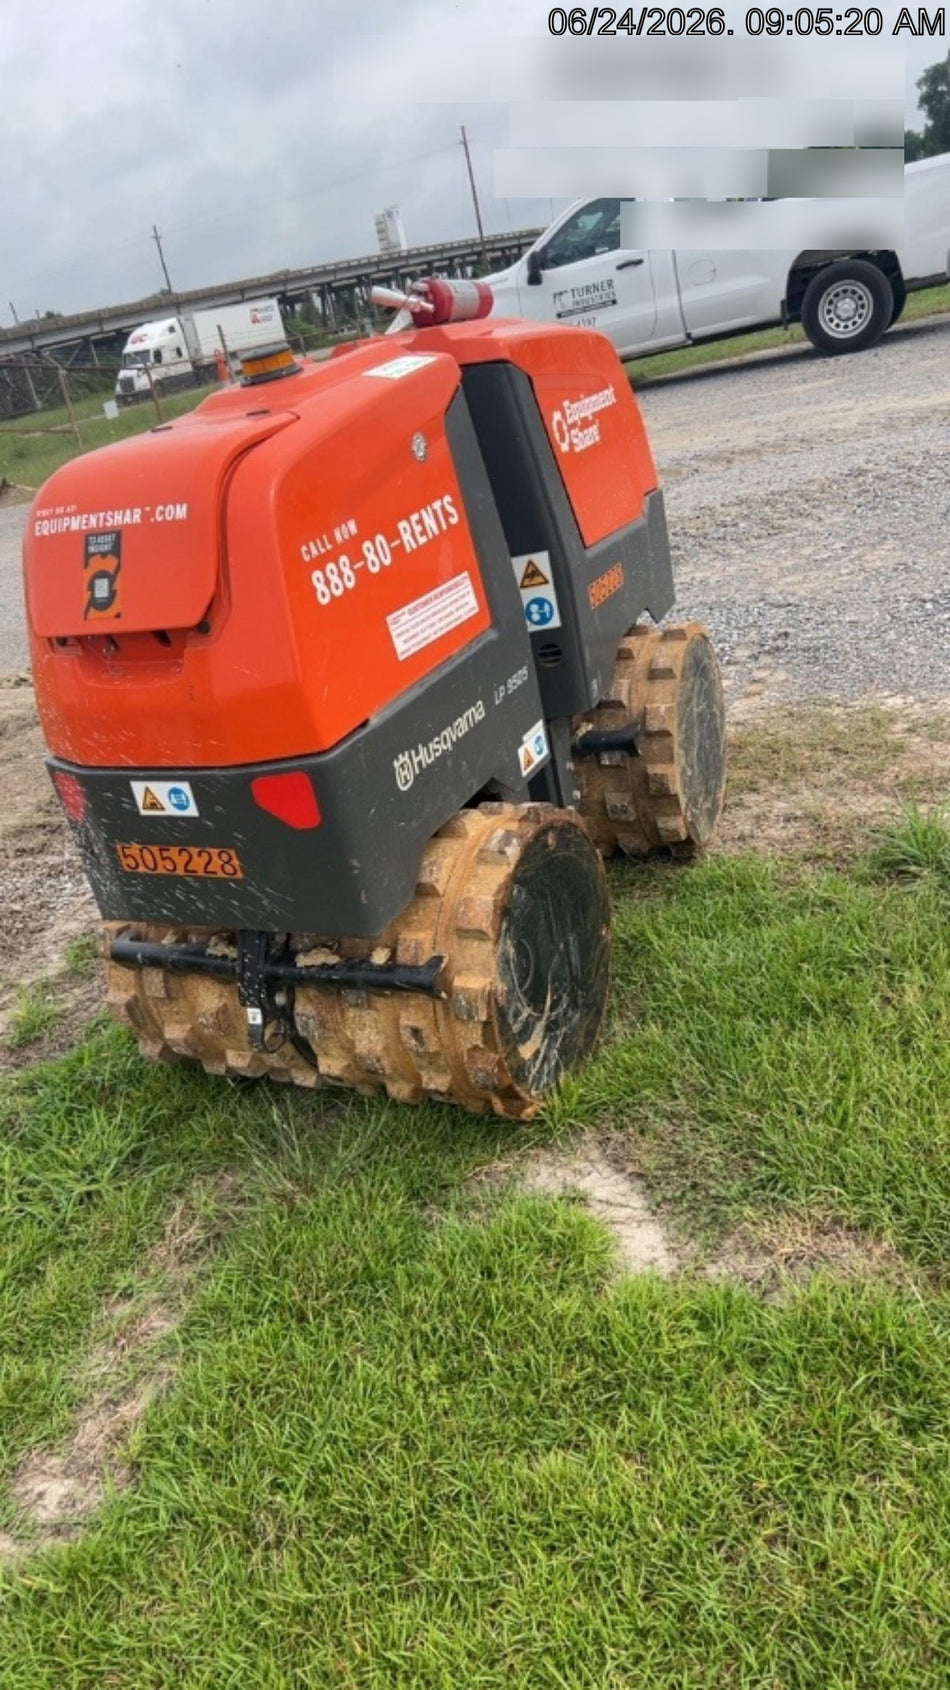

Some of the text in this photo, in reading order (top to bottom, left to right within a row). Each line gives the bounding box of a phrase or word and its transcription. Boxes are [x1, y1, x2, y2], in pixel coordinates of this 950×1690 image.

[570, 279, 615, 299] TURNER
[563, 383, 617, 426] Equipment
[570, 418, 601, 453] Share
[34, 503, 188, 536] EQUIPMENTSHAR.COM
[300, 518, 358, 562] CALL NOW
[311, 493, 459, 606] 888-80-RENTS
[410, 699, 486, 775] Husqvarna
[493, 685, 506, 705] LP
[120, 845, 238, 876] 505228
